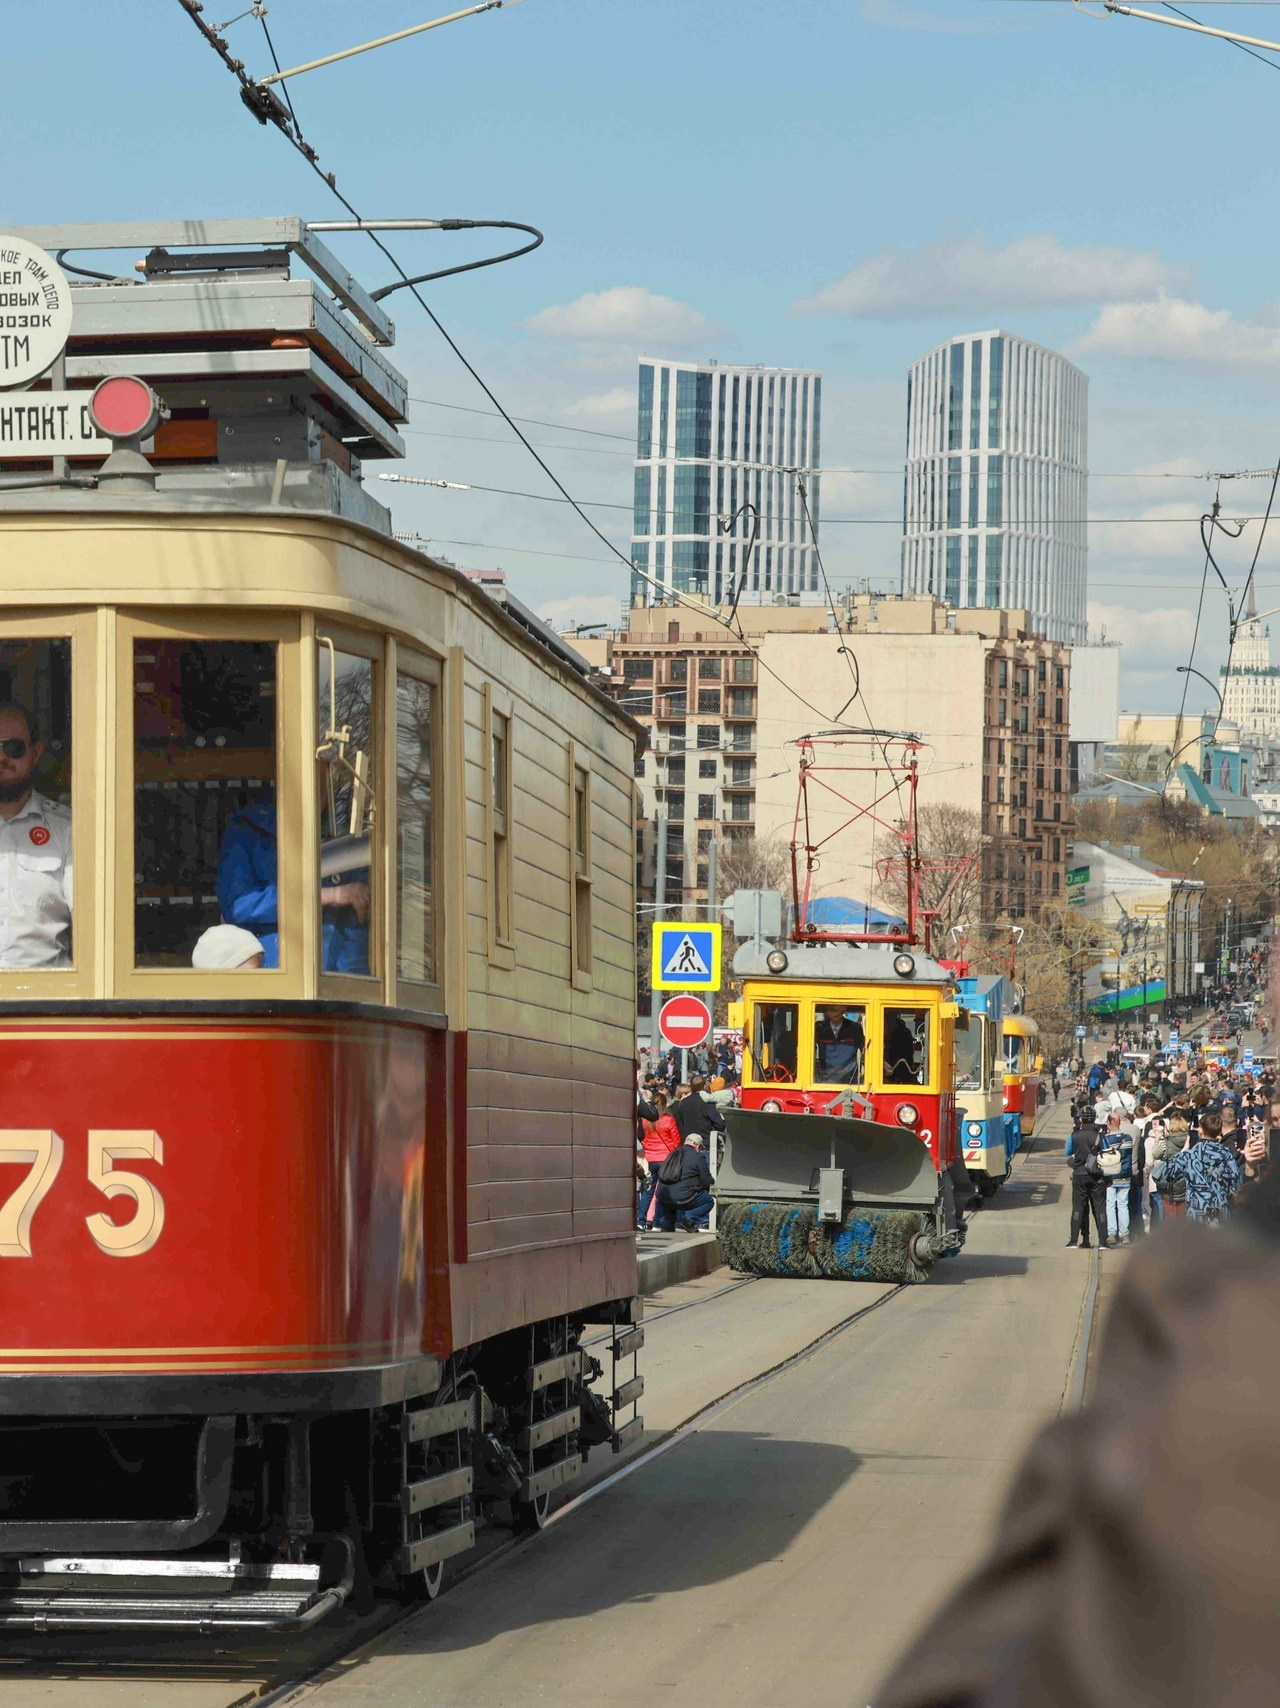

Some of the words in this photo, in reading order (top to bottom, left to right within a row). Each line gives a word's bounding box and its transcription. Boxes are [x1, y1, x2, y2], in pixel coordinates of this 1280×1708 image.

[24, 257, 49, 286] ТРАМ.
[41, 283, 60, 310] ДЕПО
[80, 405, 104, 440] С
